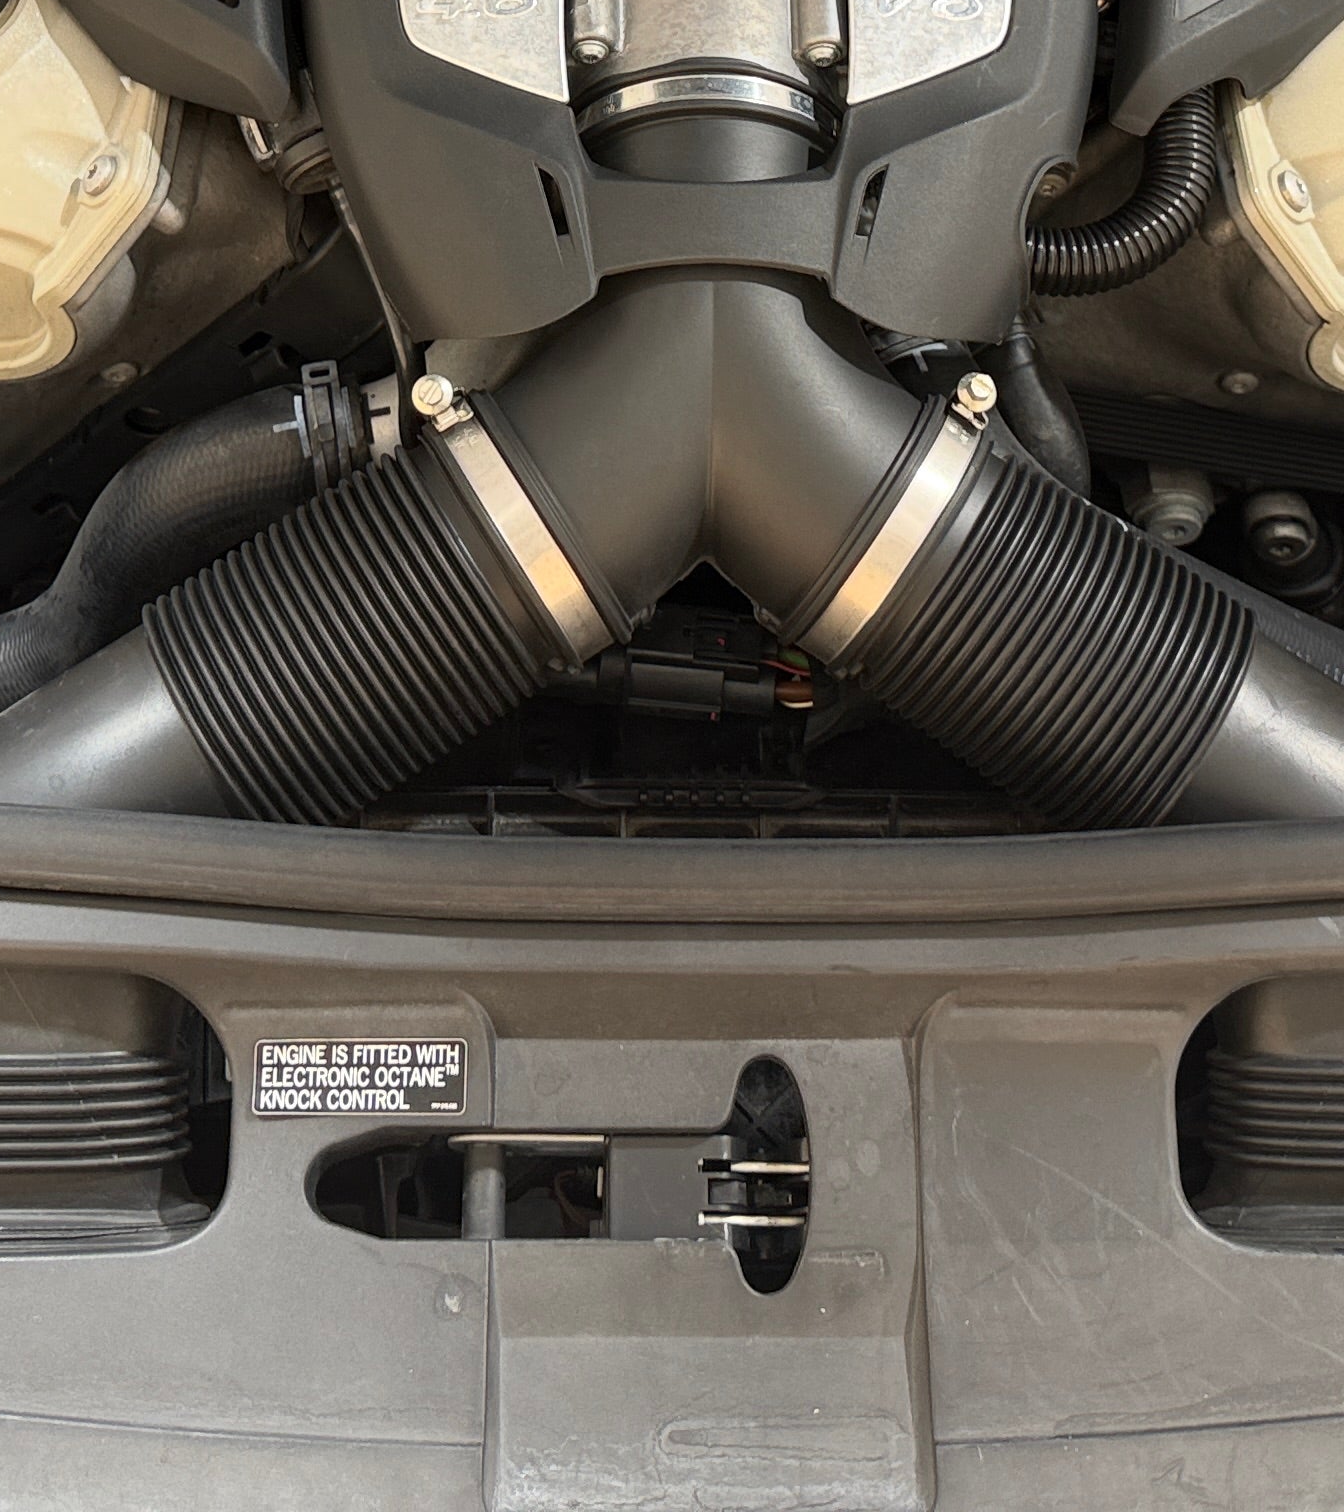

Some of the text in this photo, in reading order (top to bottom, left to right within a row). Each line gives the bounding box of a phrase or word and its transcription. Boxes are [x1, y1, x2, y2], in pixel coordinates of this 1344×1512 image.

[261, 1044, 460, 1065] ENGINE IS FITTED WITH
[260, 1067, 370, 1087] ELECTRONIC
[259, 1089, 411, 1110] KNOCK CONTROL
